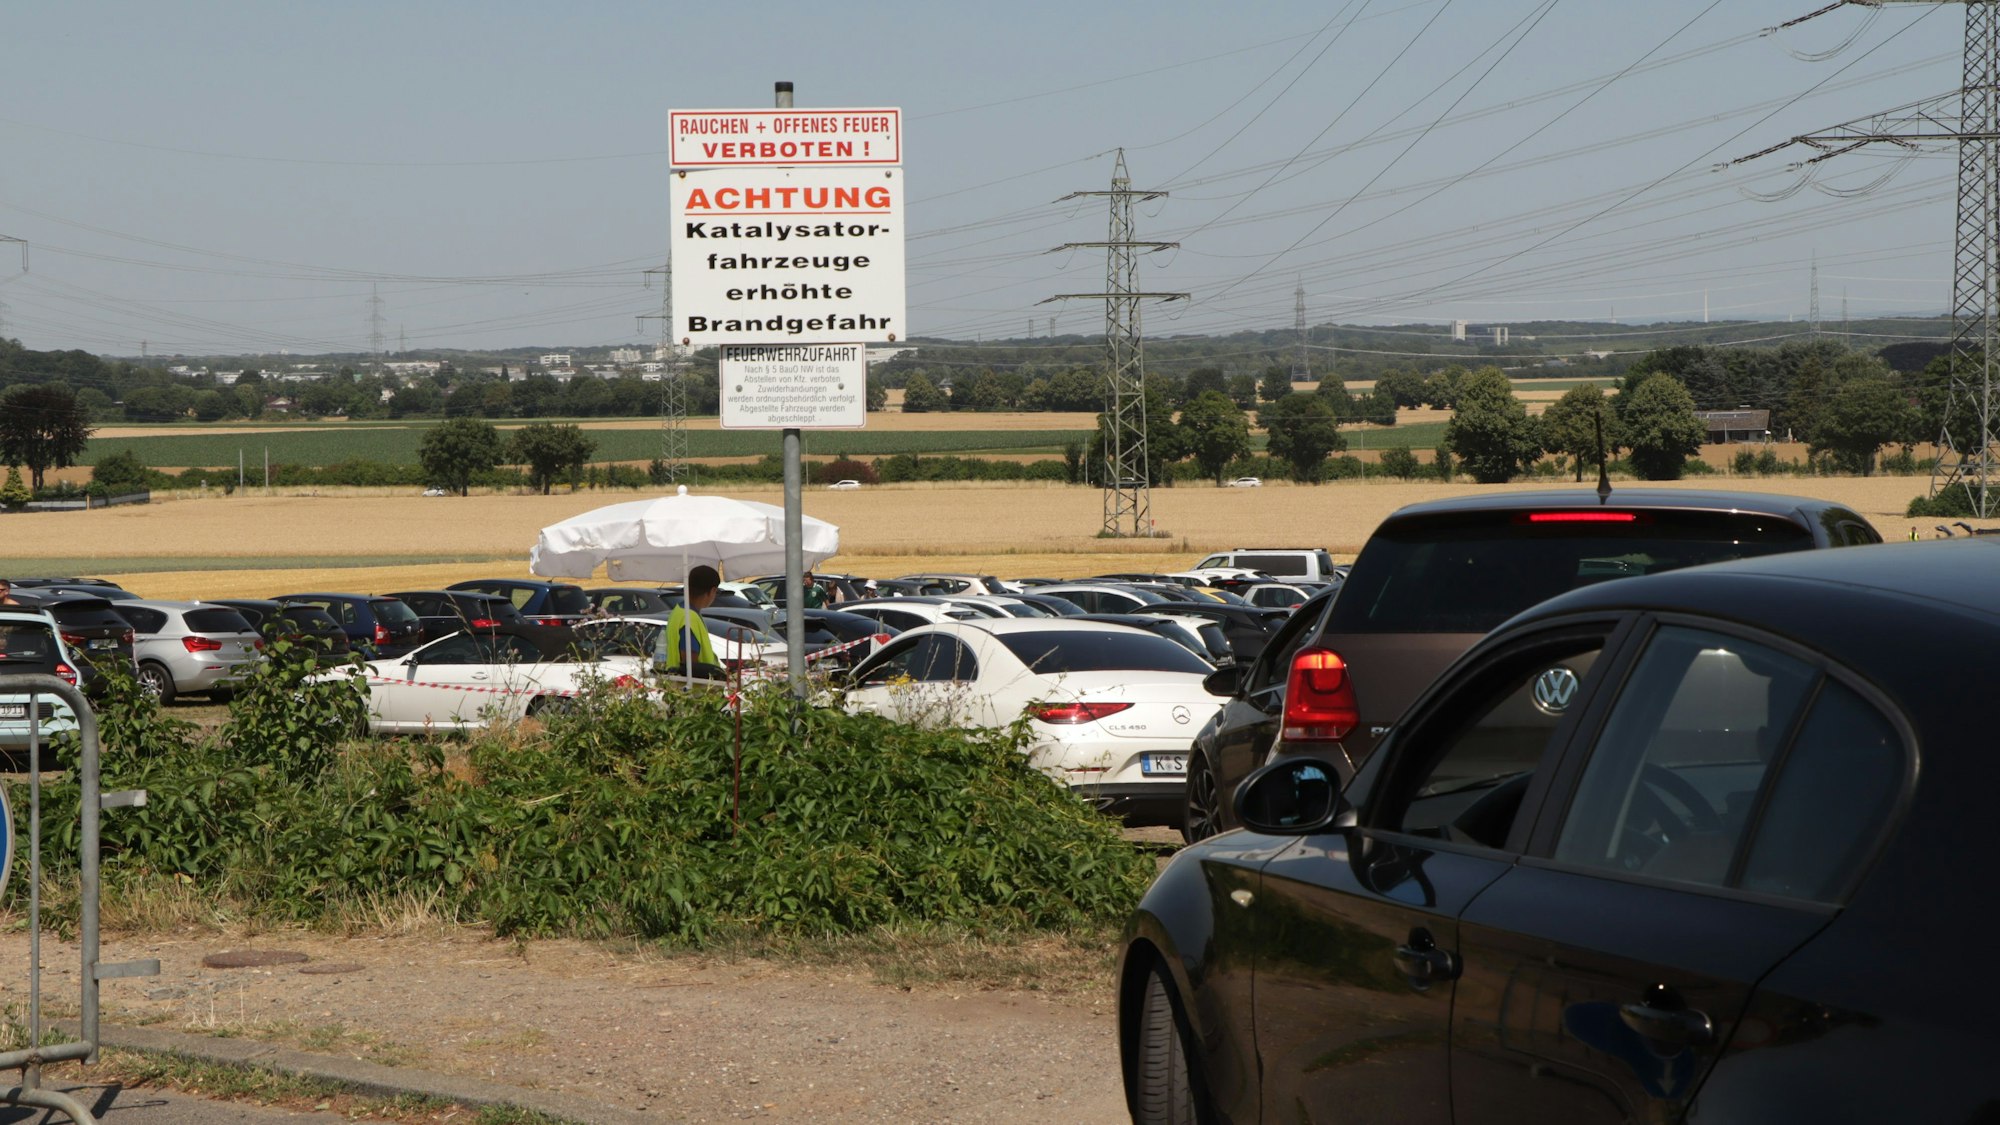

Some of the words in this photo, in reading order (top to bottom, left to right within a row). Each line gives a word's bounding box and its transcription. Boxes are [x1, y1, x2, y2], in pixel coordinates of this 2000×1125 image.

[680, 118, 749, 134] RAUCHEN
[756, 121, 766, 134] +
[773, 118, 838, 133] OFFENES
[843, 117, 889, 133] FEUER
[702, 141, 852, 158] VERBOTEN
[685, 186, 891, 210] ACHTUNG
[686, 221, 890, 241] Katalysator-
[707, 253, 870, 271] fahrzeuge
[726, 282, 853, 300] erhöhte
[688, 313, 891, 335] Brandgefahr
[726, 347, 857, 362] FEUERWEHRZUFAHRT
[744, 365, 763, 374] Nach
[765, 365, 770, 375] §
[772, 365, 777, 373] 5
[780, 365, 799, 373] BauO
[800, 365, 814, 373] NW
[815, 365, 825, 373] ist
[826, 365, 840, 373] das
[744, 375, 777, 383] Abstellen
[757, 384, 827, 394] Zuwiderhandlungen
[728, 394, 754, 403] werden
[755, 394, 827, 405] ordnungsbehördlich
[739, 404, 779, 414] Abgestellte
[780, 404, 817, 413] Fahrzeuge
[819, 404, 846, 412] werden
[1535, 668, 1578, 709] VW
[1155, 756, 1165, 770] K
